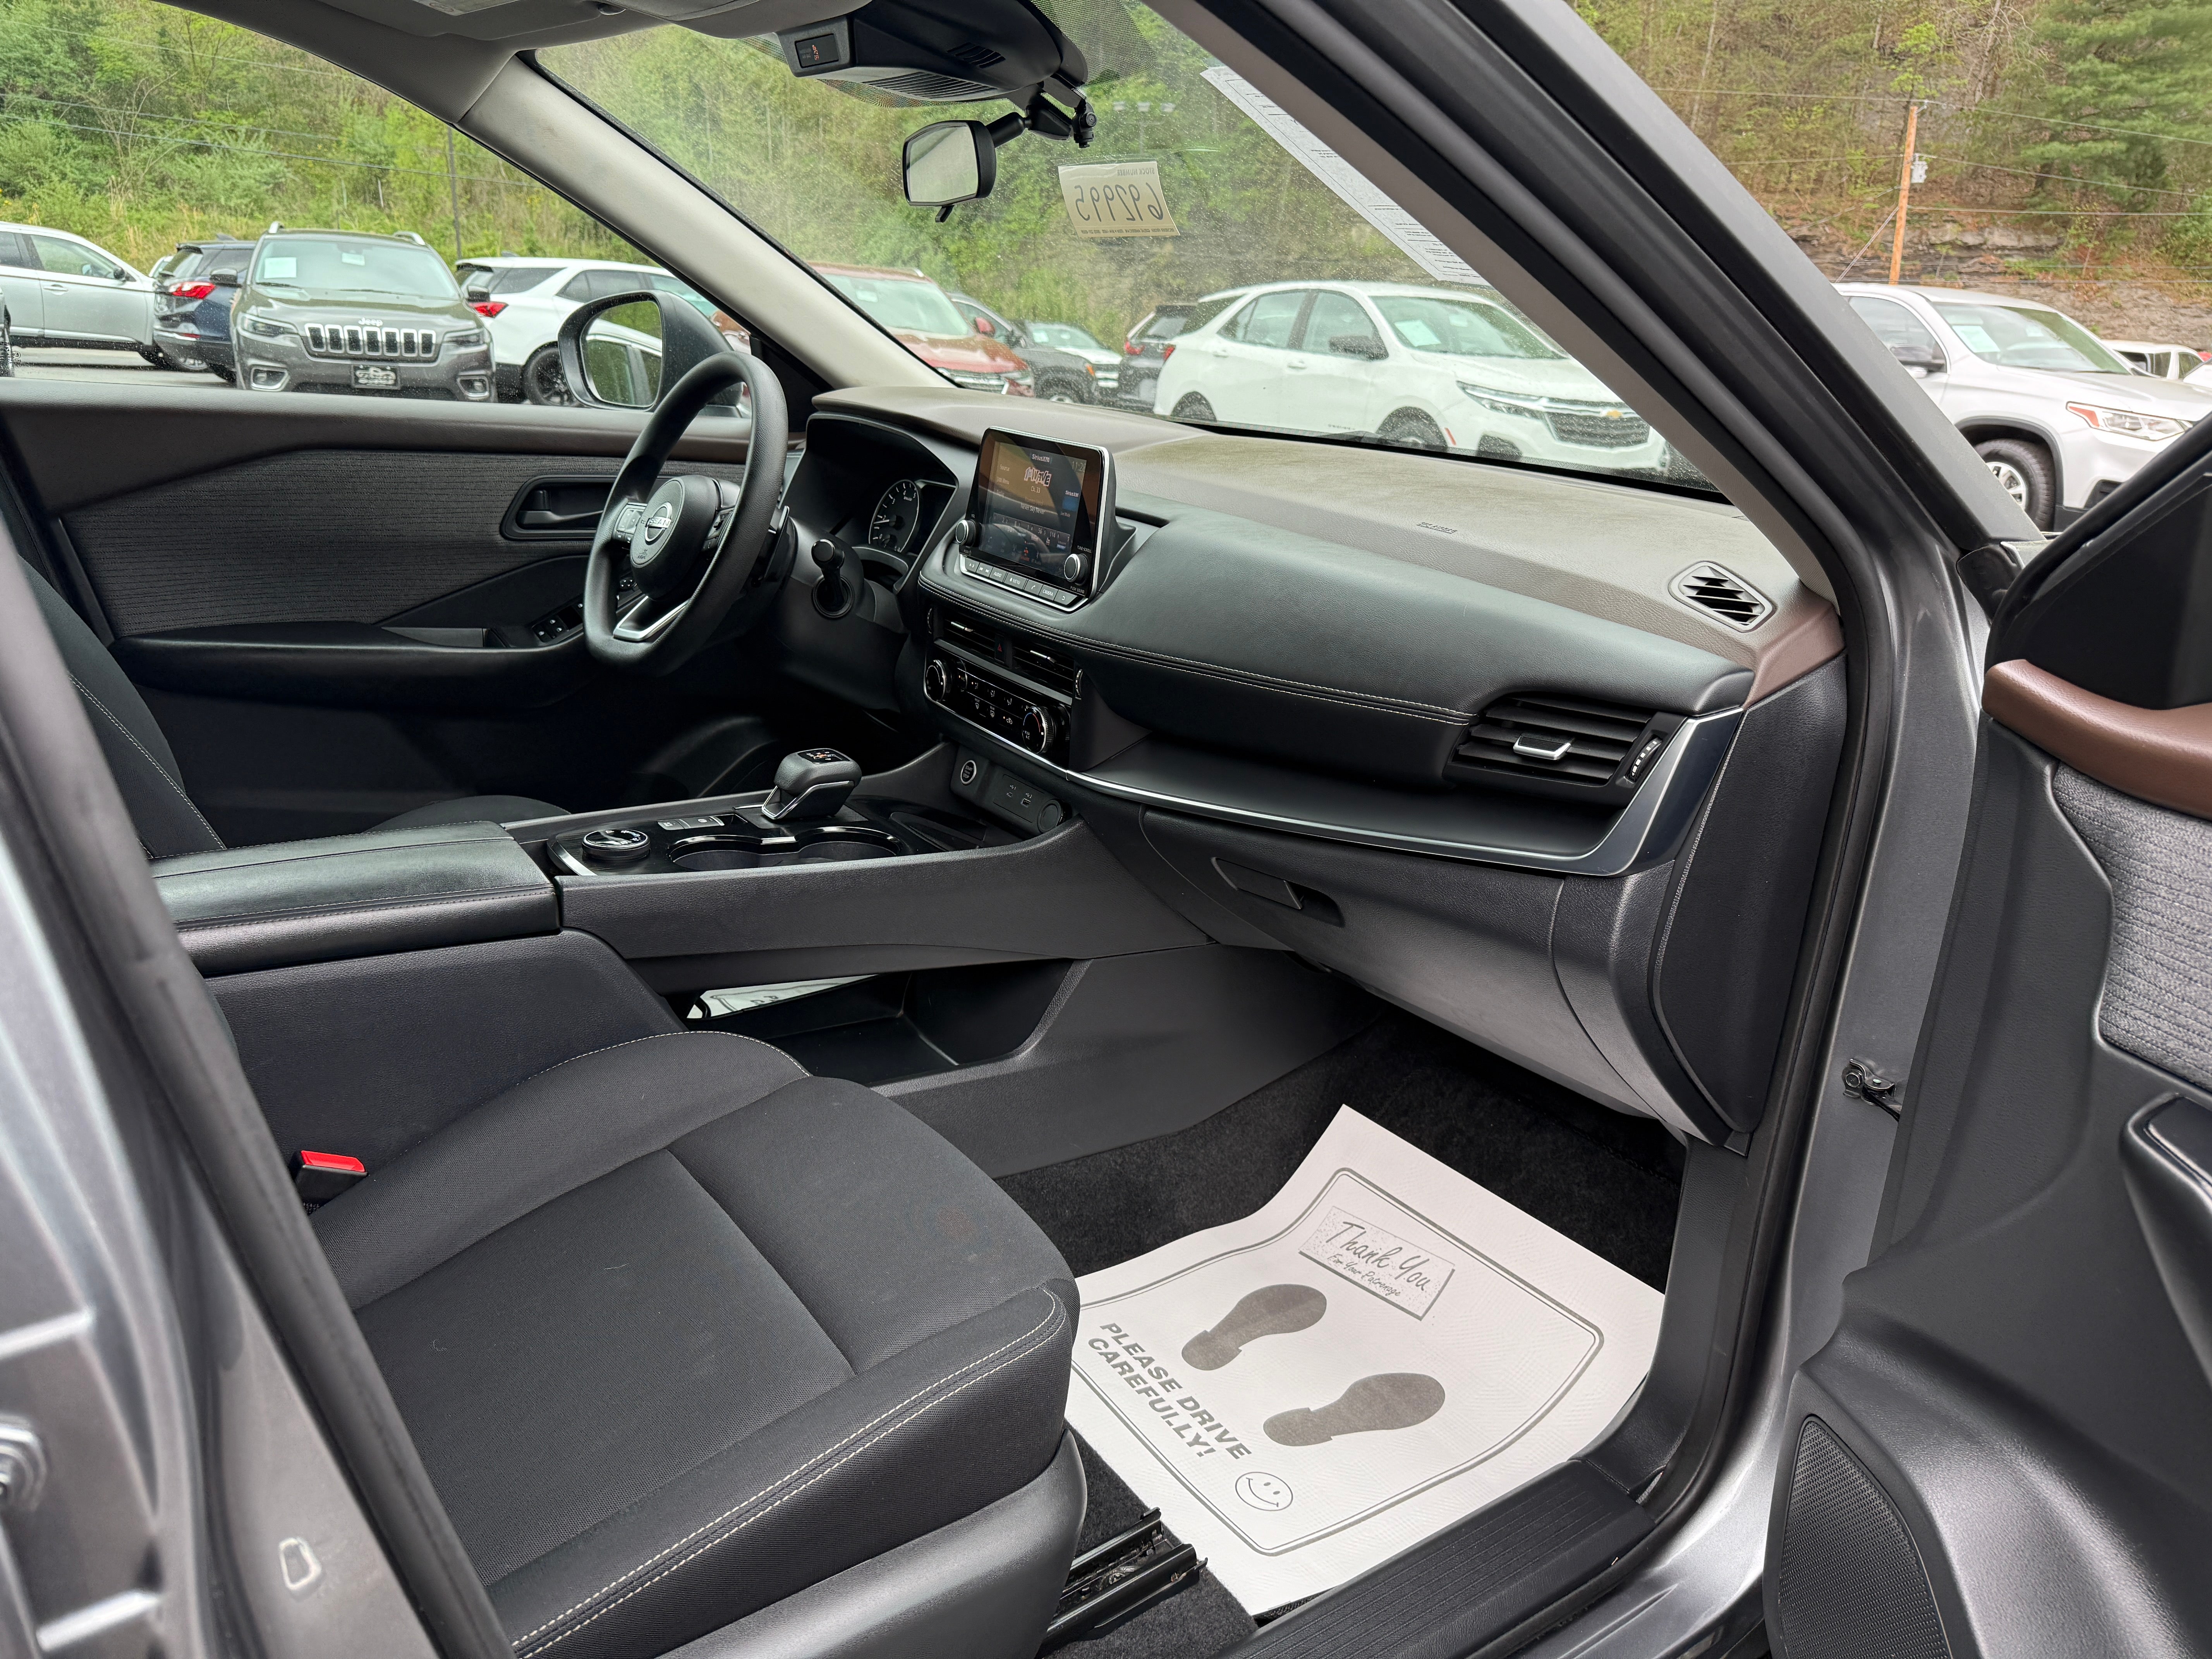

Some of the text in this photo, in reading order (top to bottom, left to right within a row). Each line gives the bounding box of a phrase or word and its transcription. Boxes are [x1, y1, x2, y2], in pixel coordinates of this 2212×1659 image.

[358, 317, 383, 327] Jeep
[1042, 589, 1054, 597] CAMERA
[1325, 1221, 1431, 1291] Thank You
[1328, 1254, 1401, 1297] For Your Patronage
[1088, 1338, 1216, 1458] CAREFULLY!
[1099, 1322, 1252, 1459] PLEASE DRIVE
